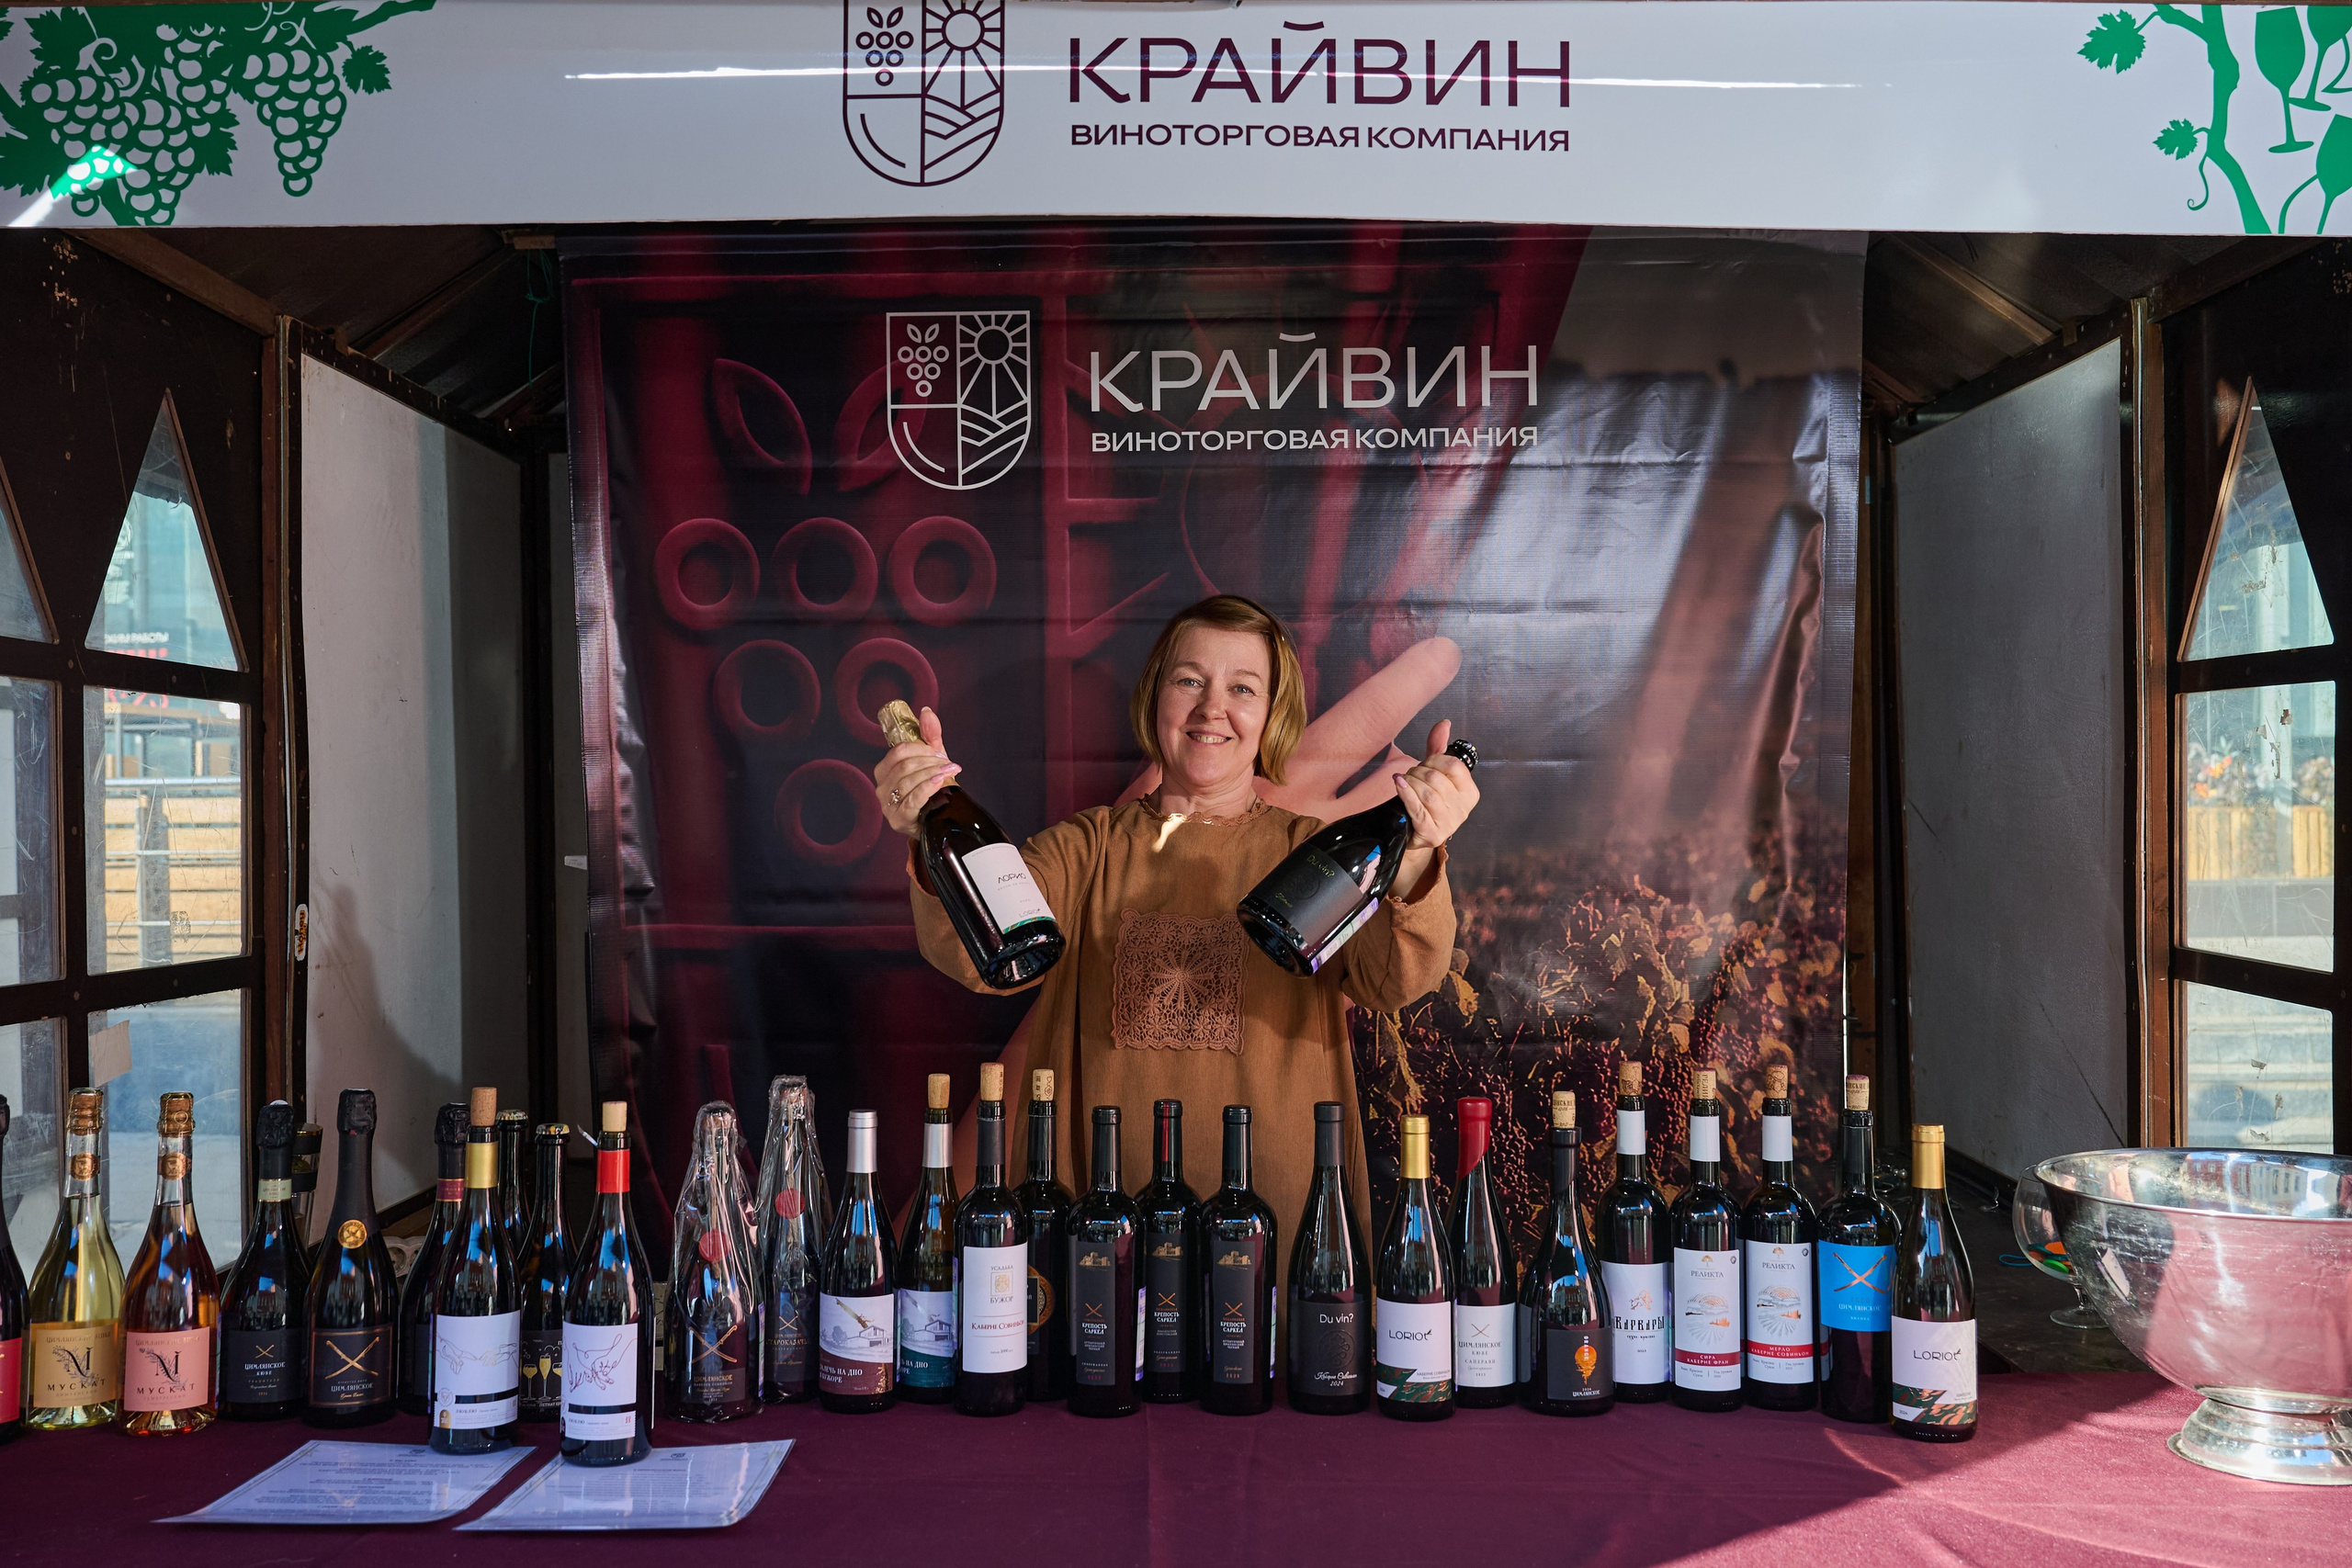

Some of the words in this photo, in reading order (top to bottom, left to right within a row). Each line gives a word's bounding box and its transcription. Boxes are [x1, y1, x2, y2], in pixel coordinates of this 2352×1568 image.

[1069, 20, 1570, 107] КРАЙВИН
[1071, 123, 1360, 147] ВИНОТОРГОВАЯ
[1367, 127, 1569, 152] КОМПАНИЯ
[1091, 333, 1538, 412] КРАЙВИН
[1091, 429, 1349, 452] ВИНОТОРГОВАЯ
[1355, 426, 1538, 449] КОМПАНИЯ
[1762, 1261, 1796, 1269] РЕЛИКТА
[1690, 1269, 1724, 1278] РЕЛИКТА
[990, 1296, 1013, 1304] БУЖОР
[1838, 1303, 1882, 1312] ЦИМЛЯНСКОЕ
[1319, 1314, 1333, 1324] Du
[1335, 1313, 1354, 1324] vin?
[1751, 1348, 1774, 1357] КАБЕРНЕ
[914, 1360, 928, 1369] ДНО
[847, 1369, 863, 1377] ДНО
[694, 1374, 733, 1382] ЦИМЛЯНСКОЕ
[48, 1379, 106, 1392] МУСКАТ
[137, 1383, 195, 1394] МУСКАТ
[331, 1382, 374, 1392] ЦИМЛЯНСКОЕ
